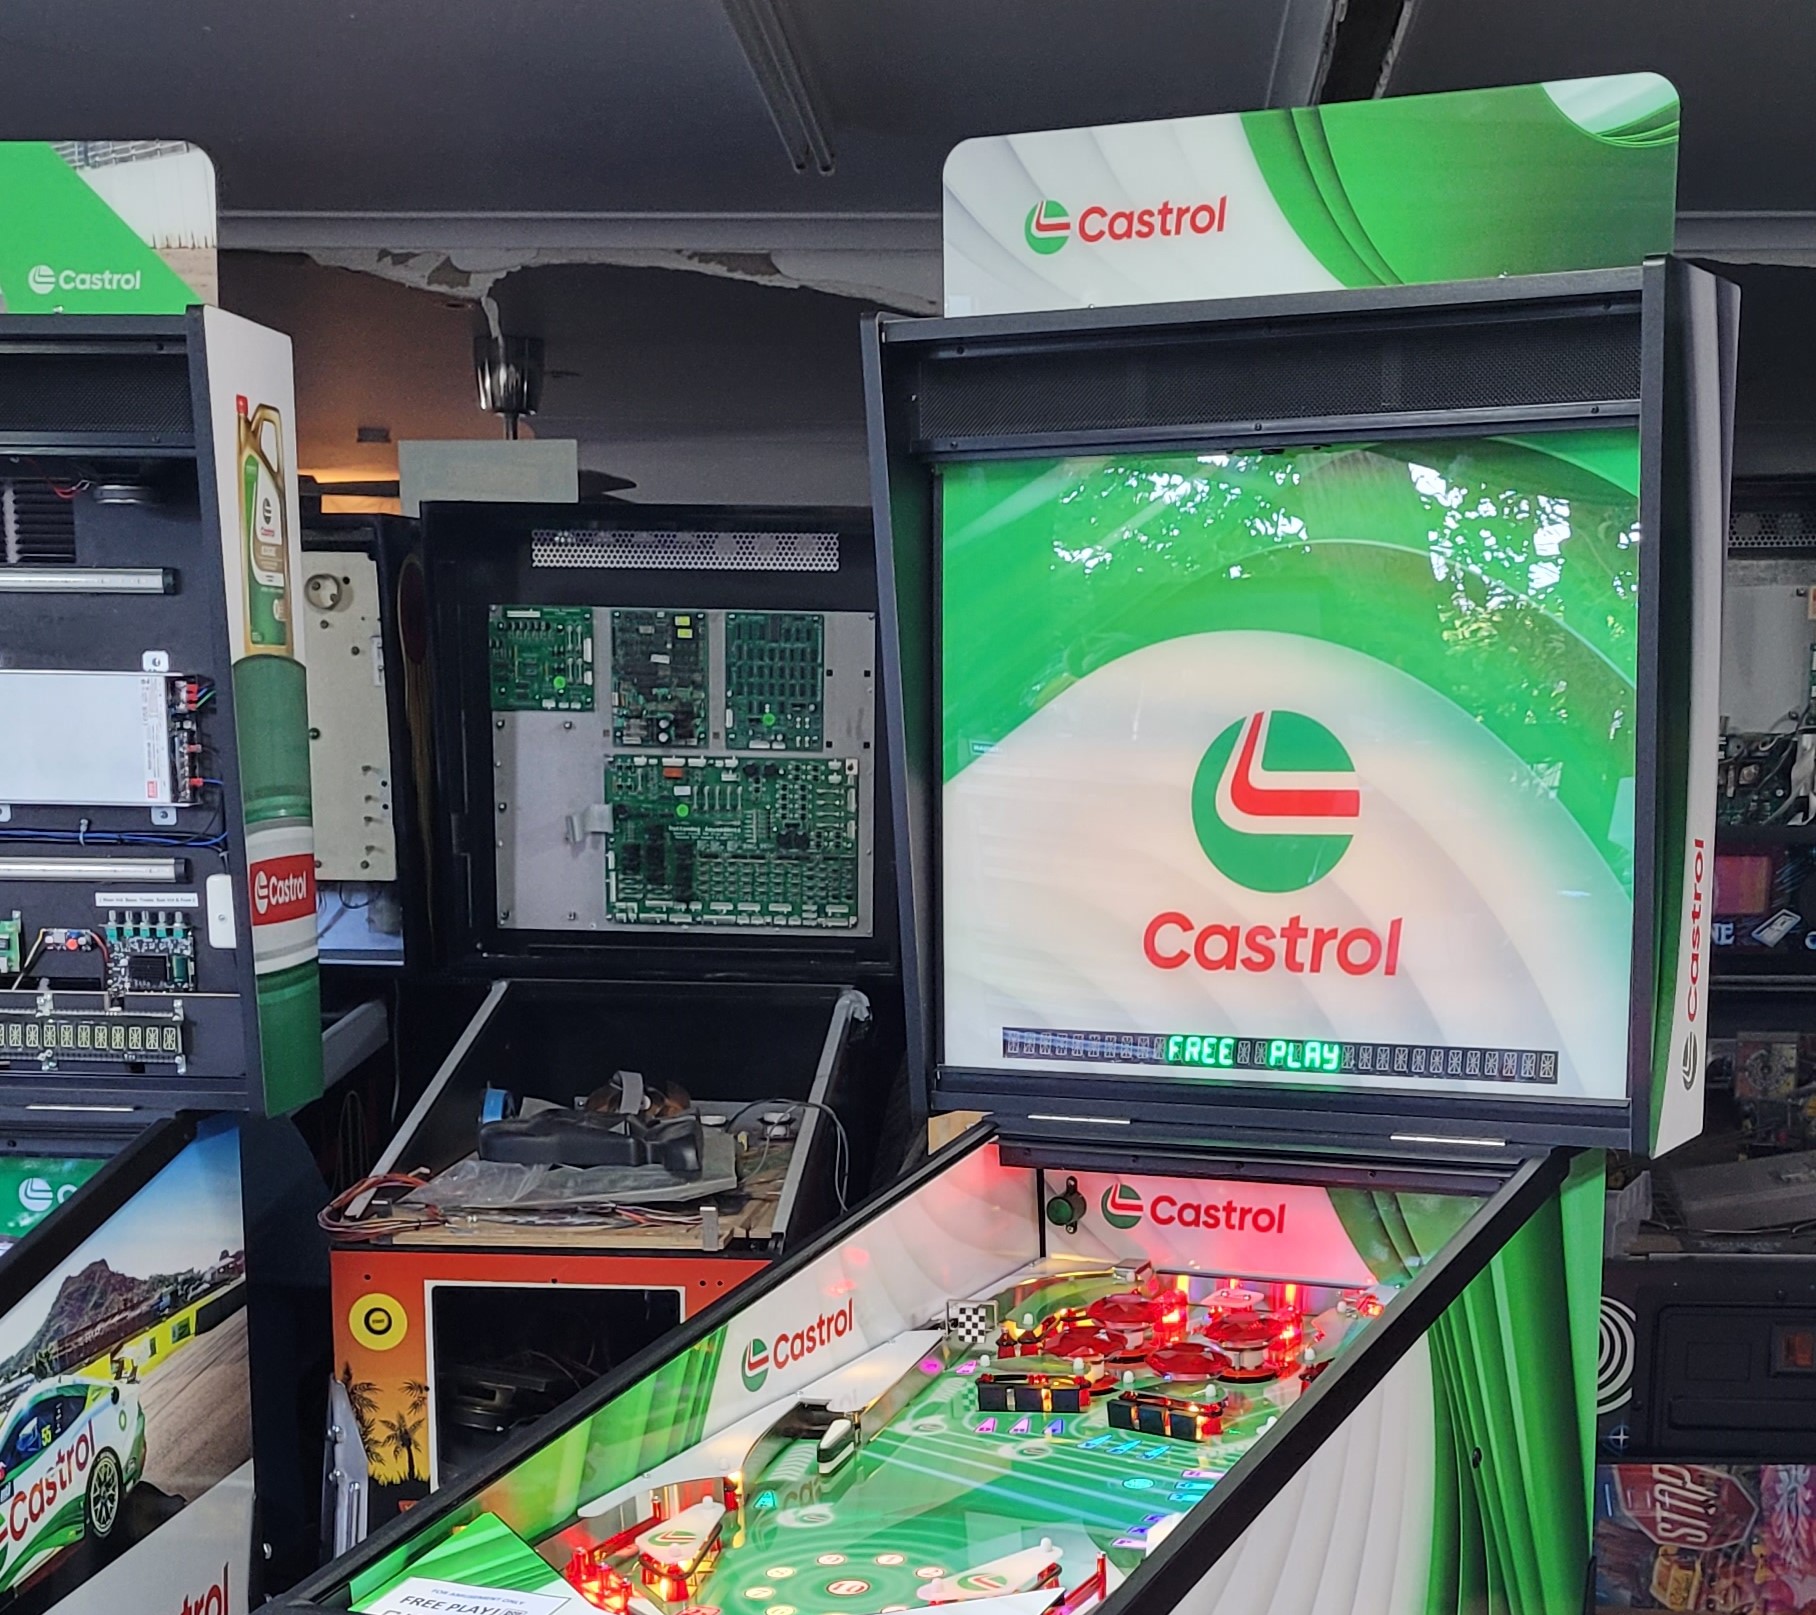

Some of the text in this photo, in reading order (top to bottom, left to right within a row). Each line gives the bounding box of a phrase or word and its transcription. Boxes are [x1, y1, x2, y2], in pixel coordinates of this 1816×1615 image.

[1078, 195, 1227, 242] Castrol
[58, 269, 141, 290] Castrol
[269, 870, 307, 905] Castrol
[1143, 911, 1403, 976] Castrol
[1687, 838, 1704, 1022] Castrol
[1167, 1035, 1341, 1071] FREE PLAY
[1150, 1195, 1286, 1234] Castrol
[773, 1297, 853, 1370] Castrol
[9, 1418, 95, 1542] Castrol
[400, 1595, 446, 1610] FREE
